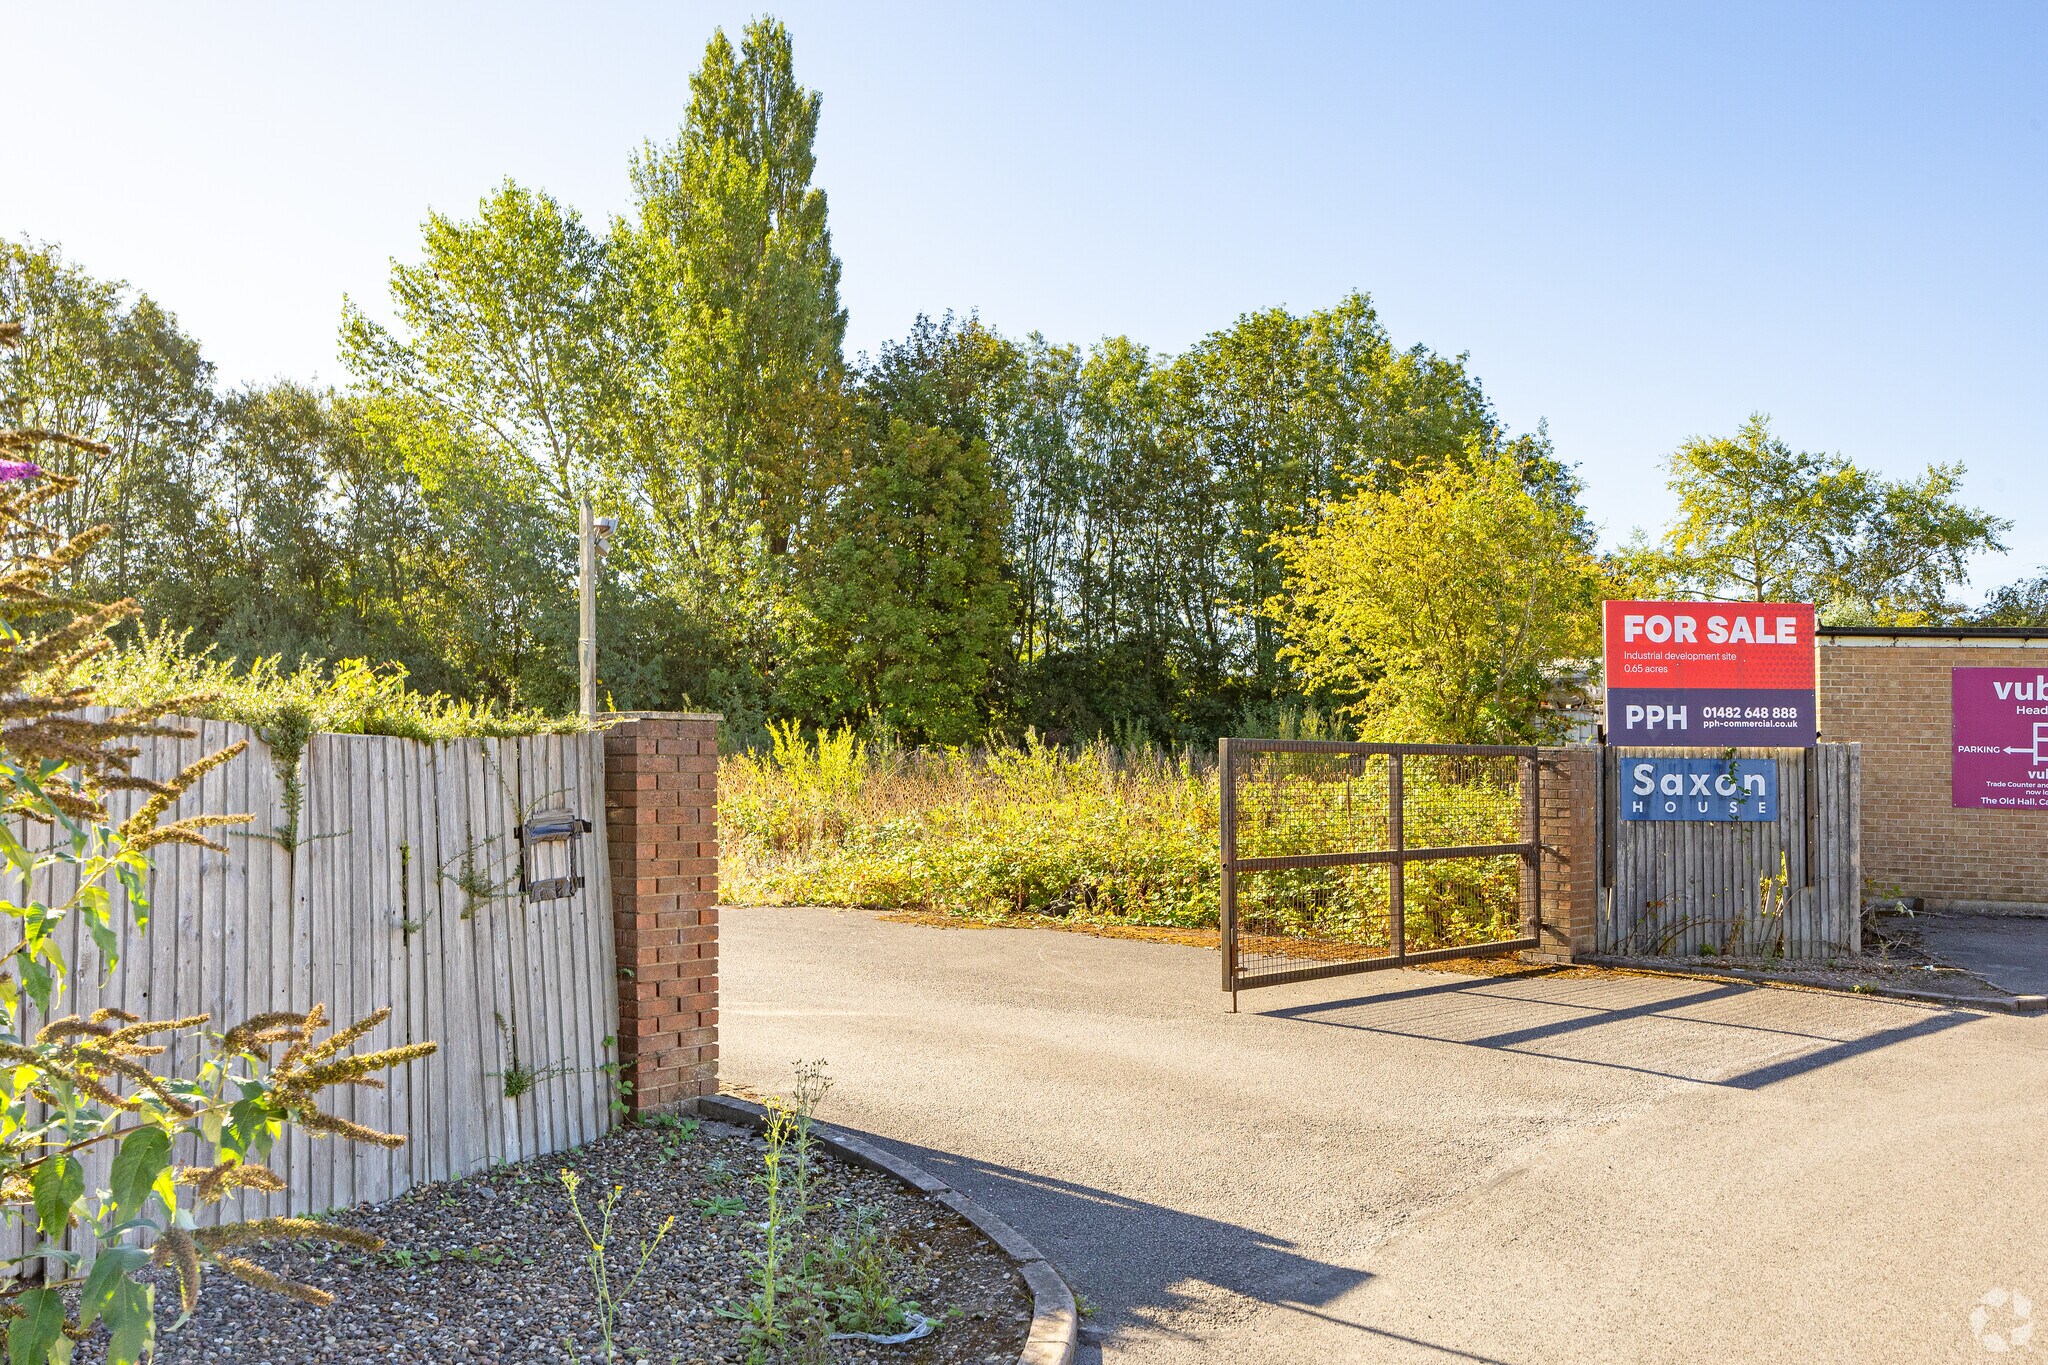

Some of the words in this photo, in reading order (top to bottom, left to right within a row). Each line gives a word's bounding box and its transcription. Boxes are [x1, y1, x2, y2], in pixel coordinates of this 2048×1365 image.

[1624, 615, 1698, 643] FOR
[1706, 616, 1797, 645] SALE
[1624, 651, 1663, 661] Industrial
[1664, 652, 1721, 663] development
[1721, 652, 1737, 662] site
[1624, 664, 1643, 674] 0.65
[1644, 665, 1668, 674] acres
[1702, 706, 1741, 719] 01482
[1744, 707, 1769, 719] 648
[1772, 707, 1797, 719] 888
[2016, 705, 2048, 715] Head
[1626, 704, 1688, 730] PPH
[1703, 719, 1798, 729] pph-commercial.co.uk
[1957, 745, 2001, 754] PARKING
[1632, 763, 1766, 797] Saxon
[2027, 768, 2048, 780] vu
[1981, 796, 1998, 805] The
[1999, 797, 2015, 805] Old
[1632, 801, 1766, 814] HOUSE
